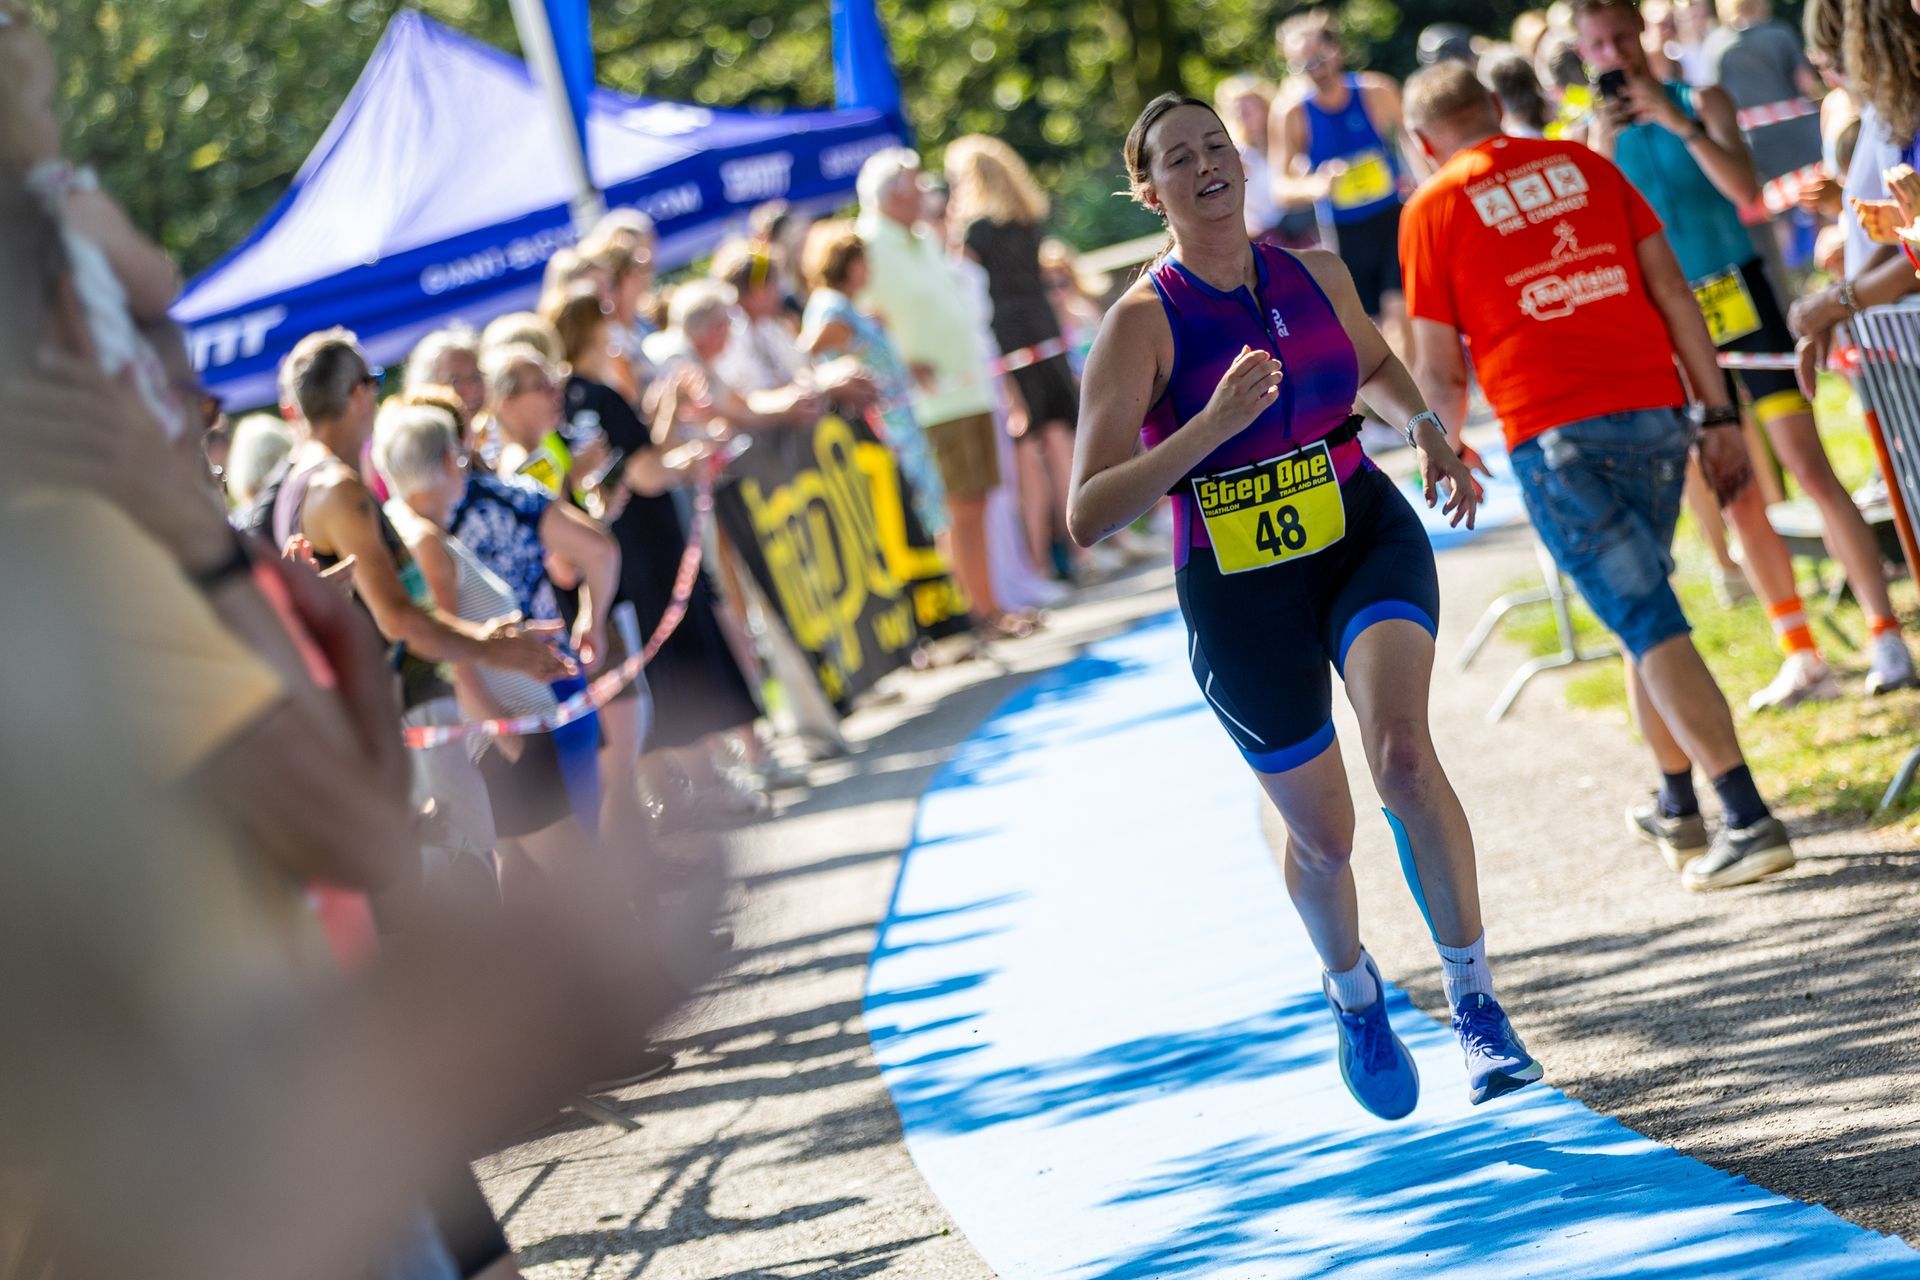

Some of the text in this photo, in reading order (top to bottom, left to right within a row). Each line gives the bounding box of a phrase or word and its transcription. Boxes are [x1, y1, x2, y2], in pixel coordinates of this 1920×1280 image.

[1201, 454, 1327, 509] Step One
[1279, 476, 1327, 498] TRAIL AND RUN
[1205, 503, 1240, 517] TRIATHLON
[1256, 505, 1306, 556] 48
